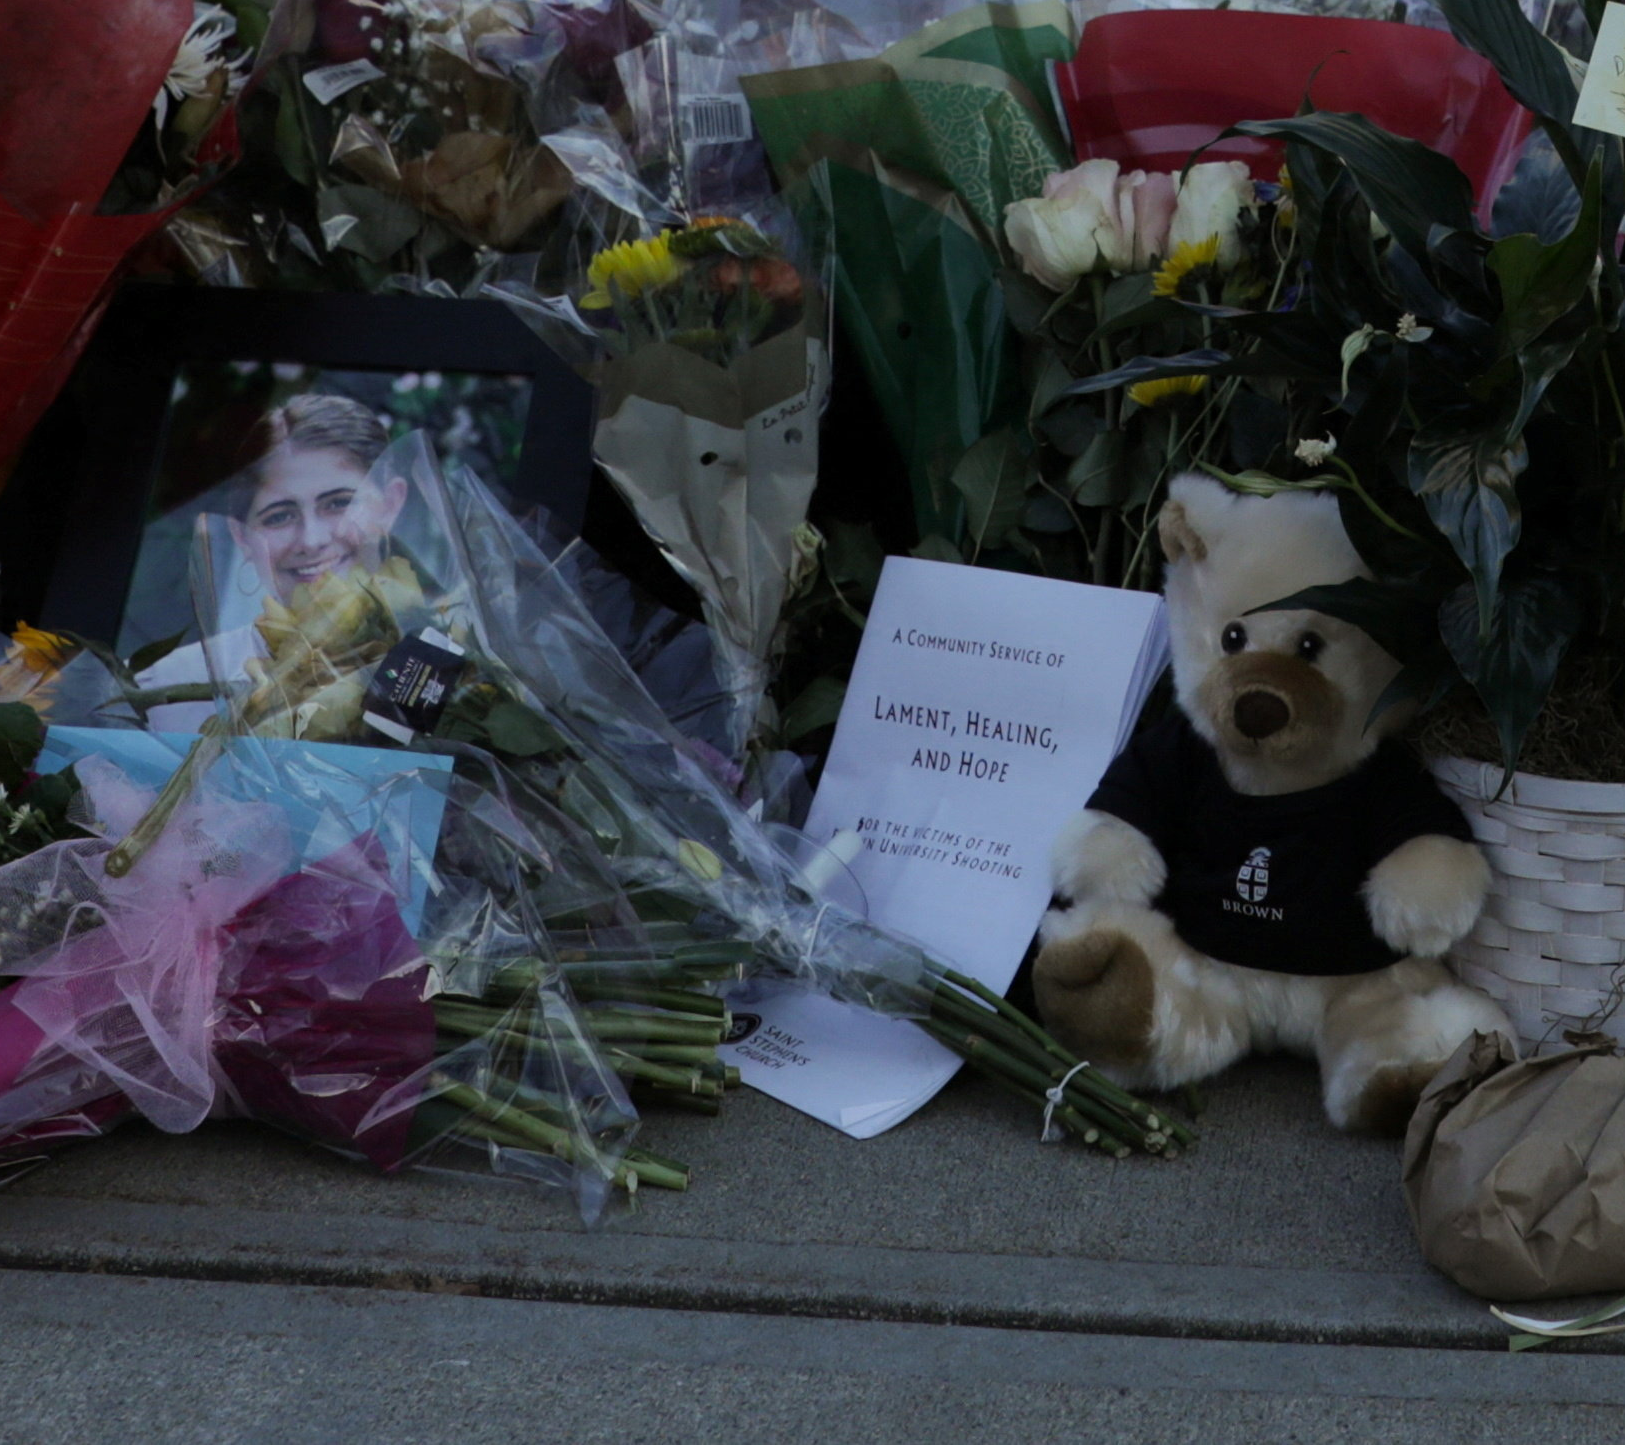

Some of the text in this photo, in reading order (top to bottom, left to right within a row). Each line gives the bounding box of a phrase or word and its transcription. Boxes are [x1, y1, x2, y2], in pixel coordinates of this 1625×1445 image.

[892, 628, 903, 644] A
[1046, 653, 1065, 668] OF
[874, 695, 1059, 754] LAMENT, HEALING,
[911, 748, 1009, 783] AND HOPE
[885, 822, 909, 838] THE
[913, 827, 962, 847] VICTIMS
[965, 837, 983, 850] OF
[987, 841, 1011, 857] THE
[951, 851, 1023, 879] SHOOTING
[1222, 898, 1284, 922] BROWN
[764, 1025, 805, 1047] SAINT
[736, 1045, 786, 1070] CHURCH
